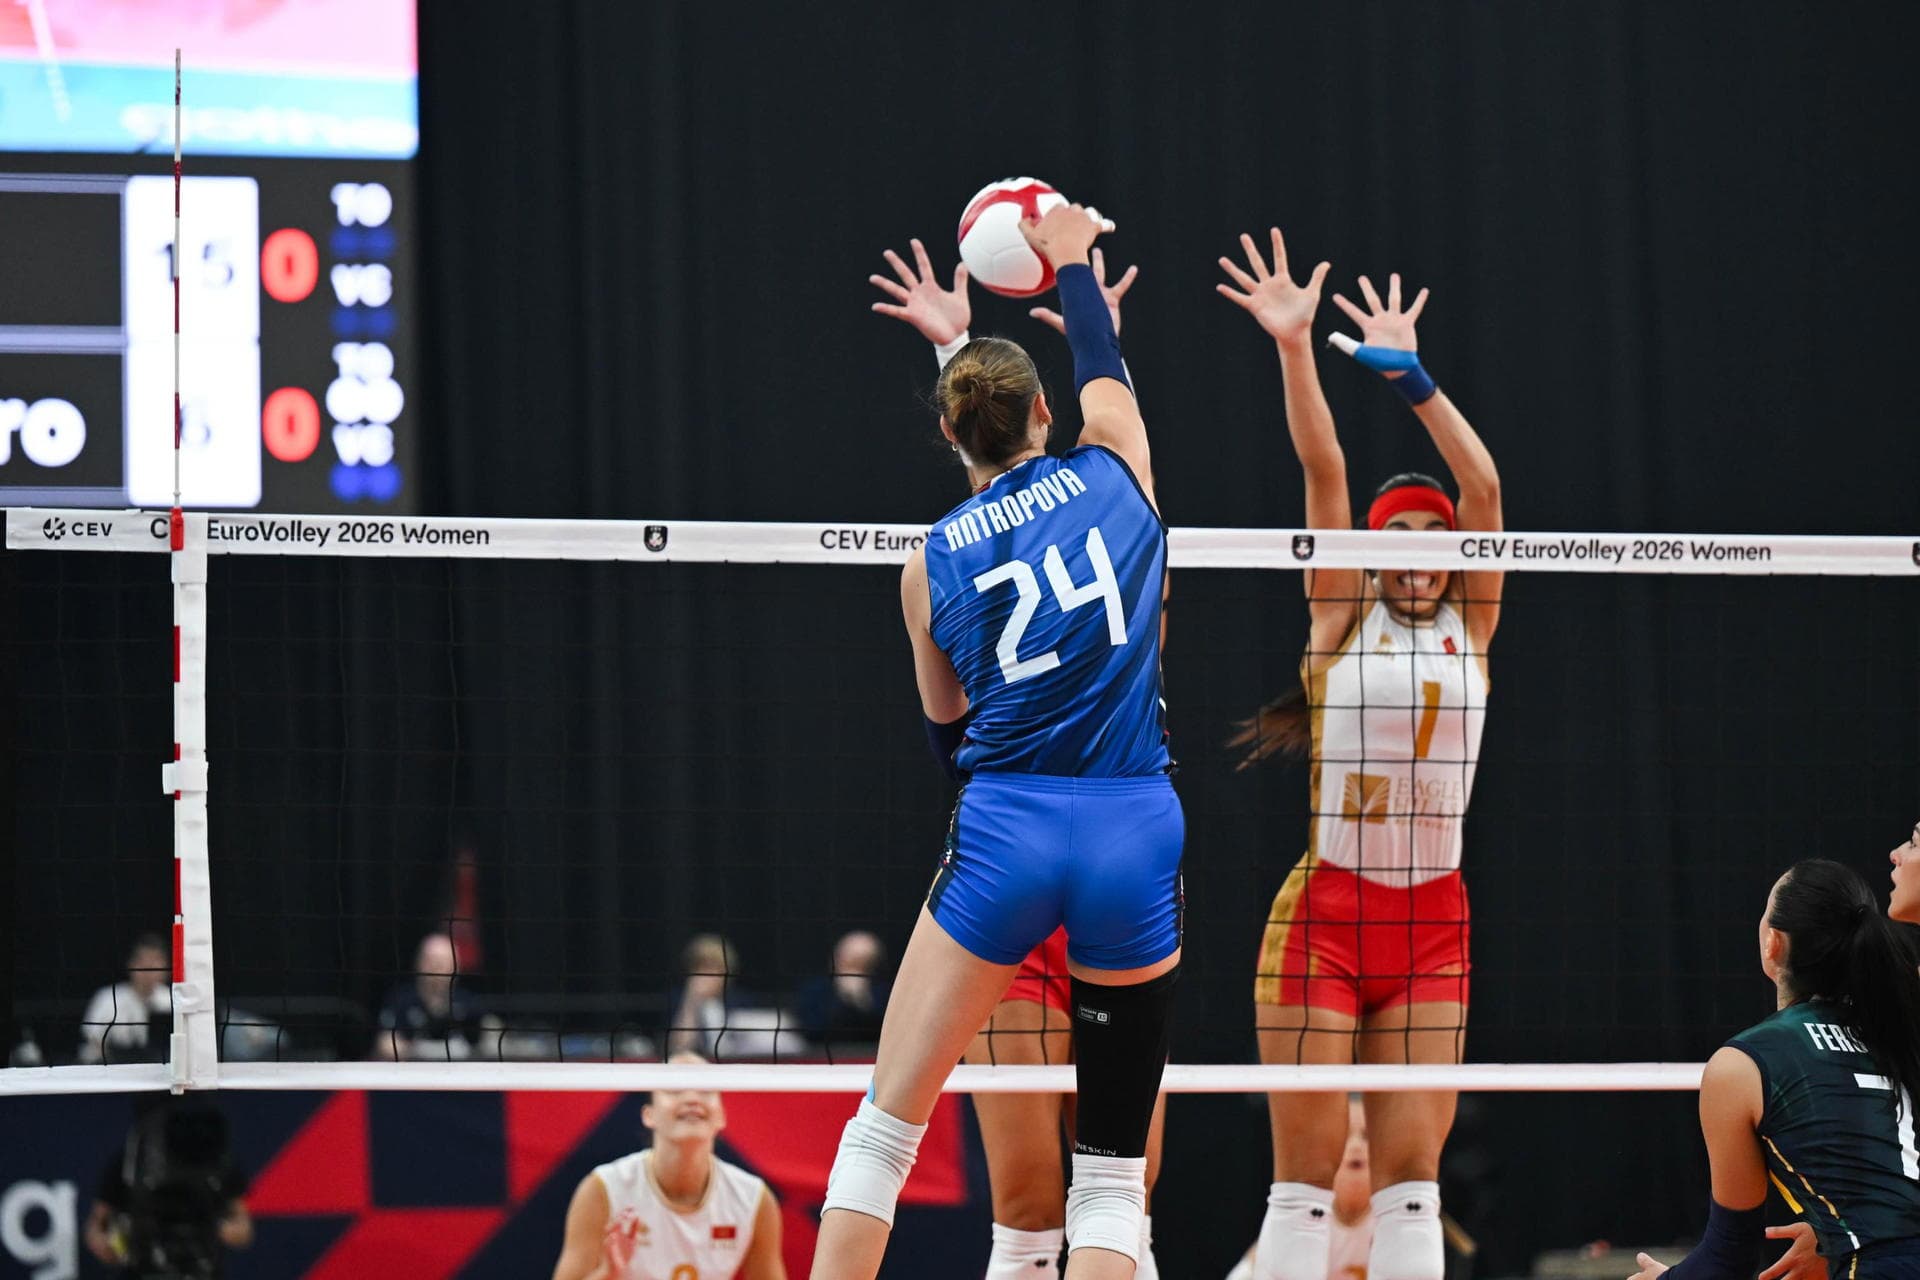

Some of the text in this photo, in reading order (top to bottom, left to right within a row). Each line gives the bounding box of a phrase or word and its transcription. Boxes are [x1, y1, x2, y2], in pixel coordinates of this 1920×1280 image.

[261, 228, 319, 303] 0
[262, 387, 320, 461] 0
[71, 522, 113, 537] CEV
[207, 519, 490, 547] EuroVolley 2026 Women
[944, 468, 1087, 552] ANTROPOVA
[820, 529, 928, 551] CEV Euro
[1460, 538, 1771, 563] CEV EuroVolley 2026 Women
[973, 526, 1128, 684] 24
